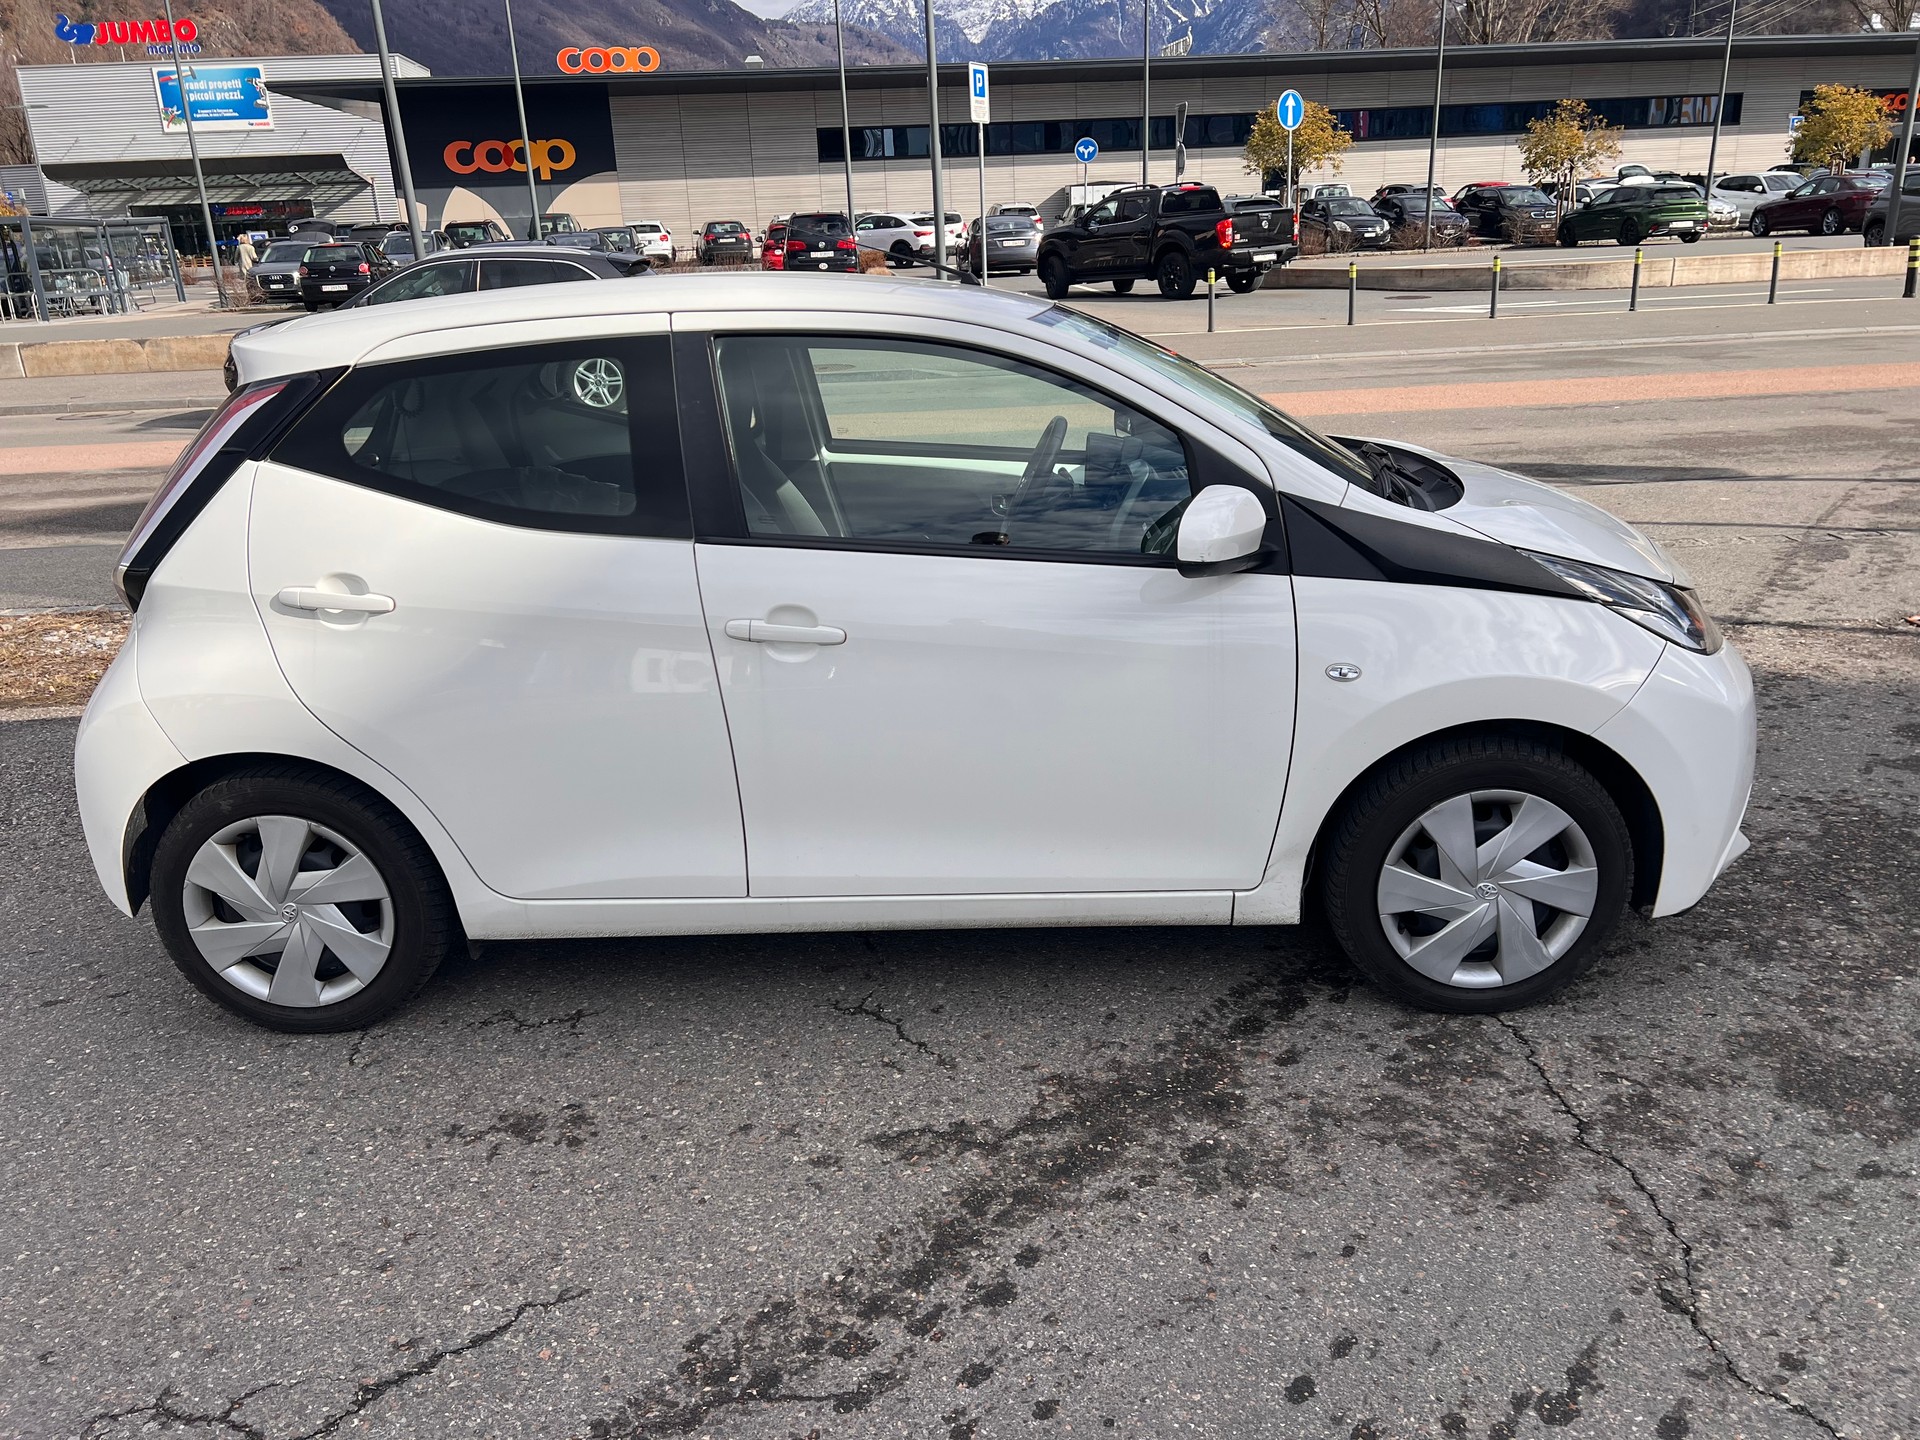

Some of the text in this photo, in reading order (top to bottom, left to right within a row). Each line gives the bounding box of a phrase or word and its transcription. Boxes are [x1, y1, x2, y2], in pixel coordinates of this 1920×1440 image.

[95, 18, 198, 45] JUMBO
[556, 46, 661, 74] coop
[183, 79, 242, 90] randi progetti
[976, 73, 983, 94] P
[190, 91, 215, 102] piccoli
[216, 90, 244, 101] prezzi.
[443, 138, 577, 181] coop
